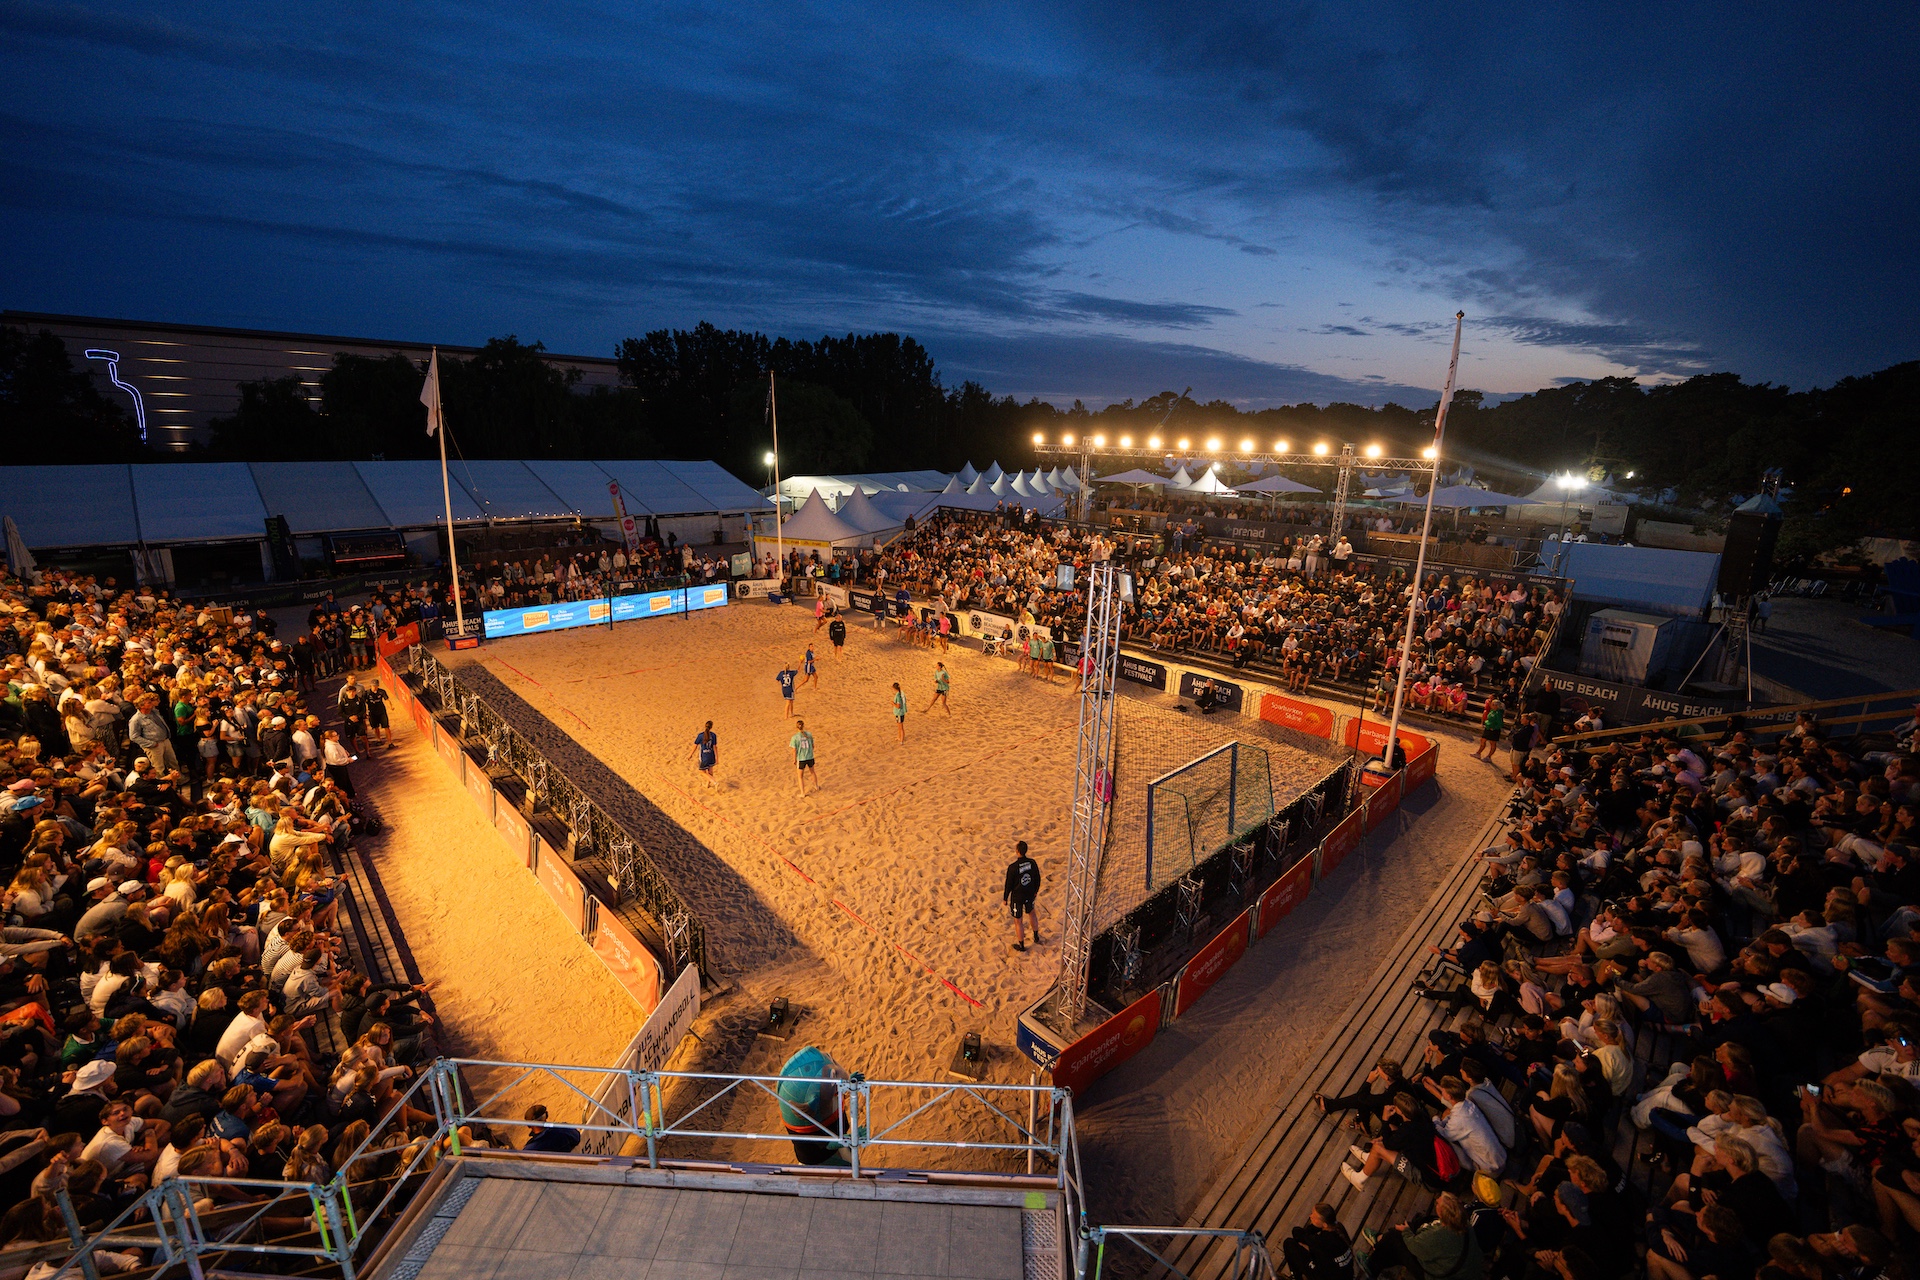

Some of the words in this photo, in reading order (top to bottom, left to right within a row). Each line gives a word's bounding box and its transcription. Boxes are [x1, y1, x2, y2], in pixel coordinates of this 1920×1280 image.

[1232, 527, 1266, 539] prenad
[1122, 659, 1138, 671] ÅHUS
[1137, 664, 1157, 676] BEACH
[1123, 668, 1153, 683] FESTIVALS
[1576, 683, 1619, 701] BEACH
[1641, 693, 1680, 714] ÅHUS
[1682, 704, 1724, 717] BEACH
[602, 922, 630, 959] Sparbanken
[614, 947, 629, 971] Skåne
[643, 987, 696, 1067] ACHHANDBOLL
[1070, 1032, 1121, 1074] Sparbanken
[1093, 1044, 1119, 1069] Skåne
